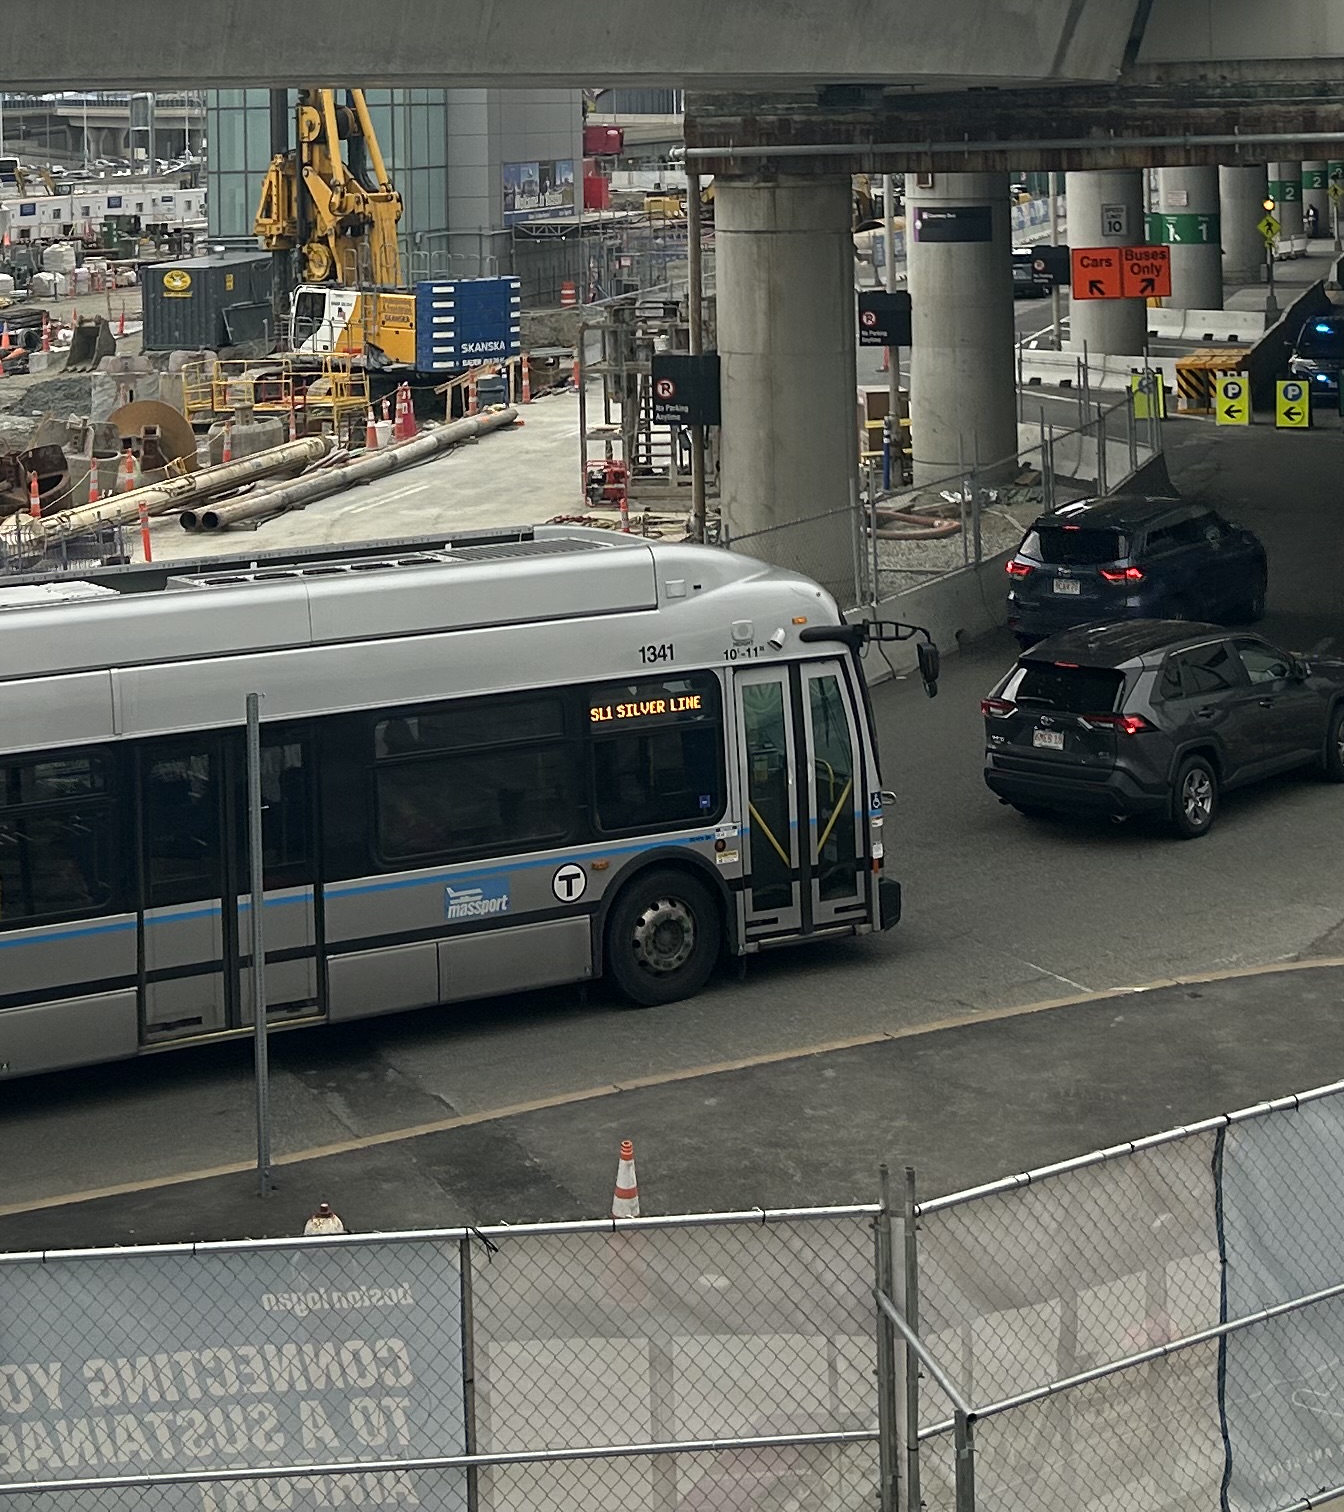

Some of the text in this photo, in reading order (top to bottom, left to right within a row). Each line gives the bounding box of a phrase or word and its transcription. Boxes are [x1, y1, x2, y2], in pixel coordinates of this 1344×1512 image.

[1312, 176, 1322, 188] 2
[1285, 187, 1295, 200] 2
[1108, 221, 1122, 232] 10
[1079, 255, 1112, 268] Cars
[1124, 249, 1167, 261] Buses
[1130, 262, 1163, 277] Only
[461, 340, 506, 354] SKANSKA
[655, 404, 689, 413] No Parking
[655, 413, 681, 421] Anytime
[638, 643, 675, 664] 1341
[590, 695, 702, 722] SL1 SILVER LINE
[558, 872, 581, 898] T
[447, 894, 508, 919] massport
